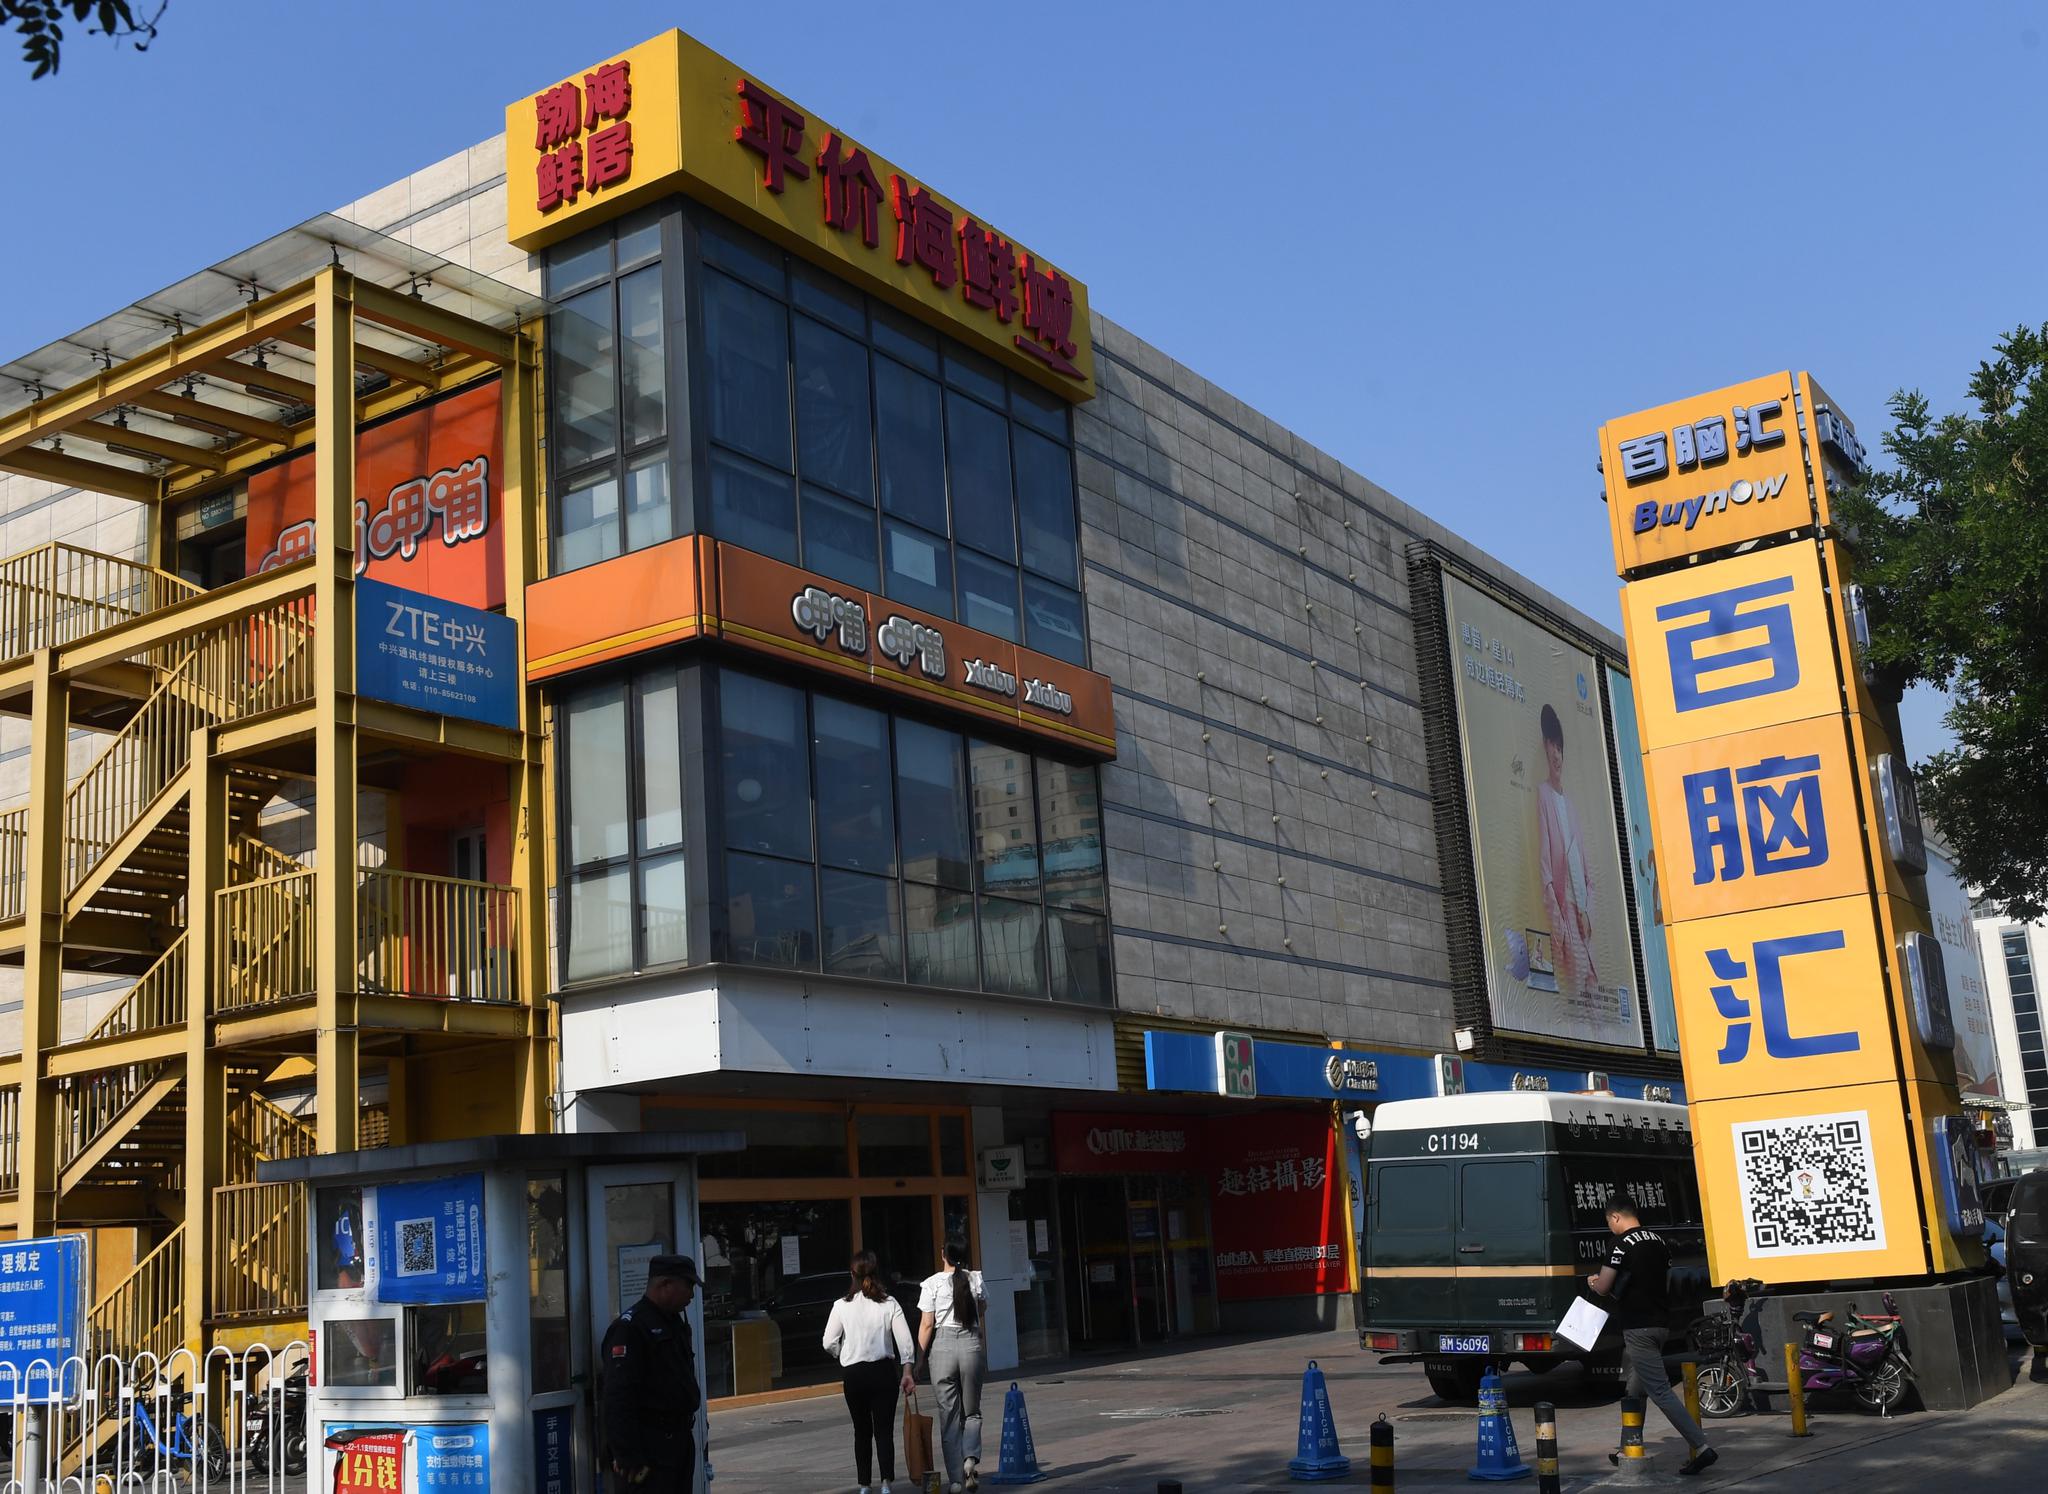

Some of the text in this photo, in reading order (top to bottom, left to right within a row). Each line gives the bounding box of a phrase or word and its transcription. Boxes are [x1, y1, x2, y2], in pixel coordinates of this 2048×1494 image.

[535, 59, 632, 150] 渤海
[536, 121, 633, 213] 鲜居
[735, 79, 1076, 357] 平价海鲜城
[1618, 400, 1785, 484] 百脑汇
[1633, 473, 1787, 534] Buynow
[378, 642, 494, 678] 中兴通讯终端授权服务中心
[418, 667, 457, 686] 请上三楼
[963, 658, 1017, 697] xiabu
[1023, 677, 1072, 715] xiabu
[1427, 1133, 1479, 1153] C1194
[1579, 1238, 1607, 1260] C1194
[1428, 1363, 1453, 1373] IVECO
[1592, 1366, 1624, 1375] IVECO
[341, 1451, 397, 1489] 1分钱
